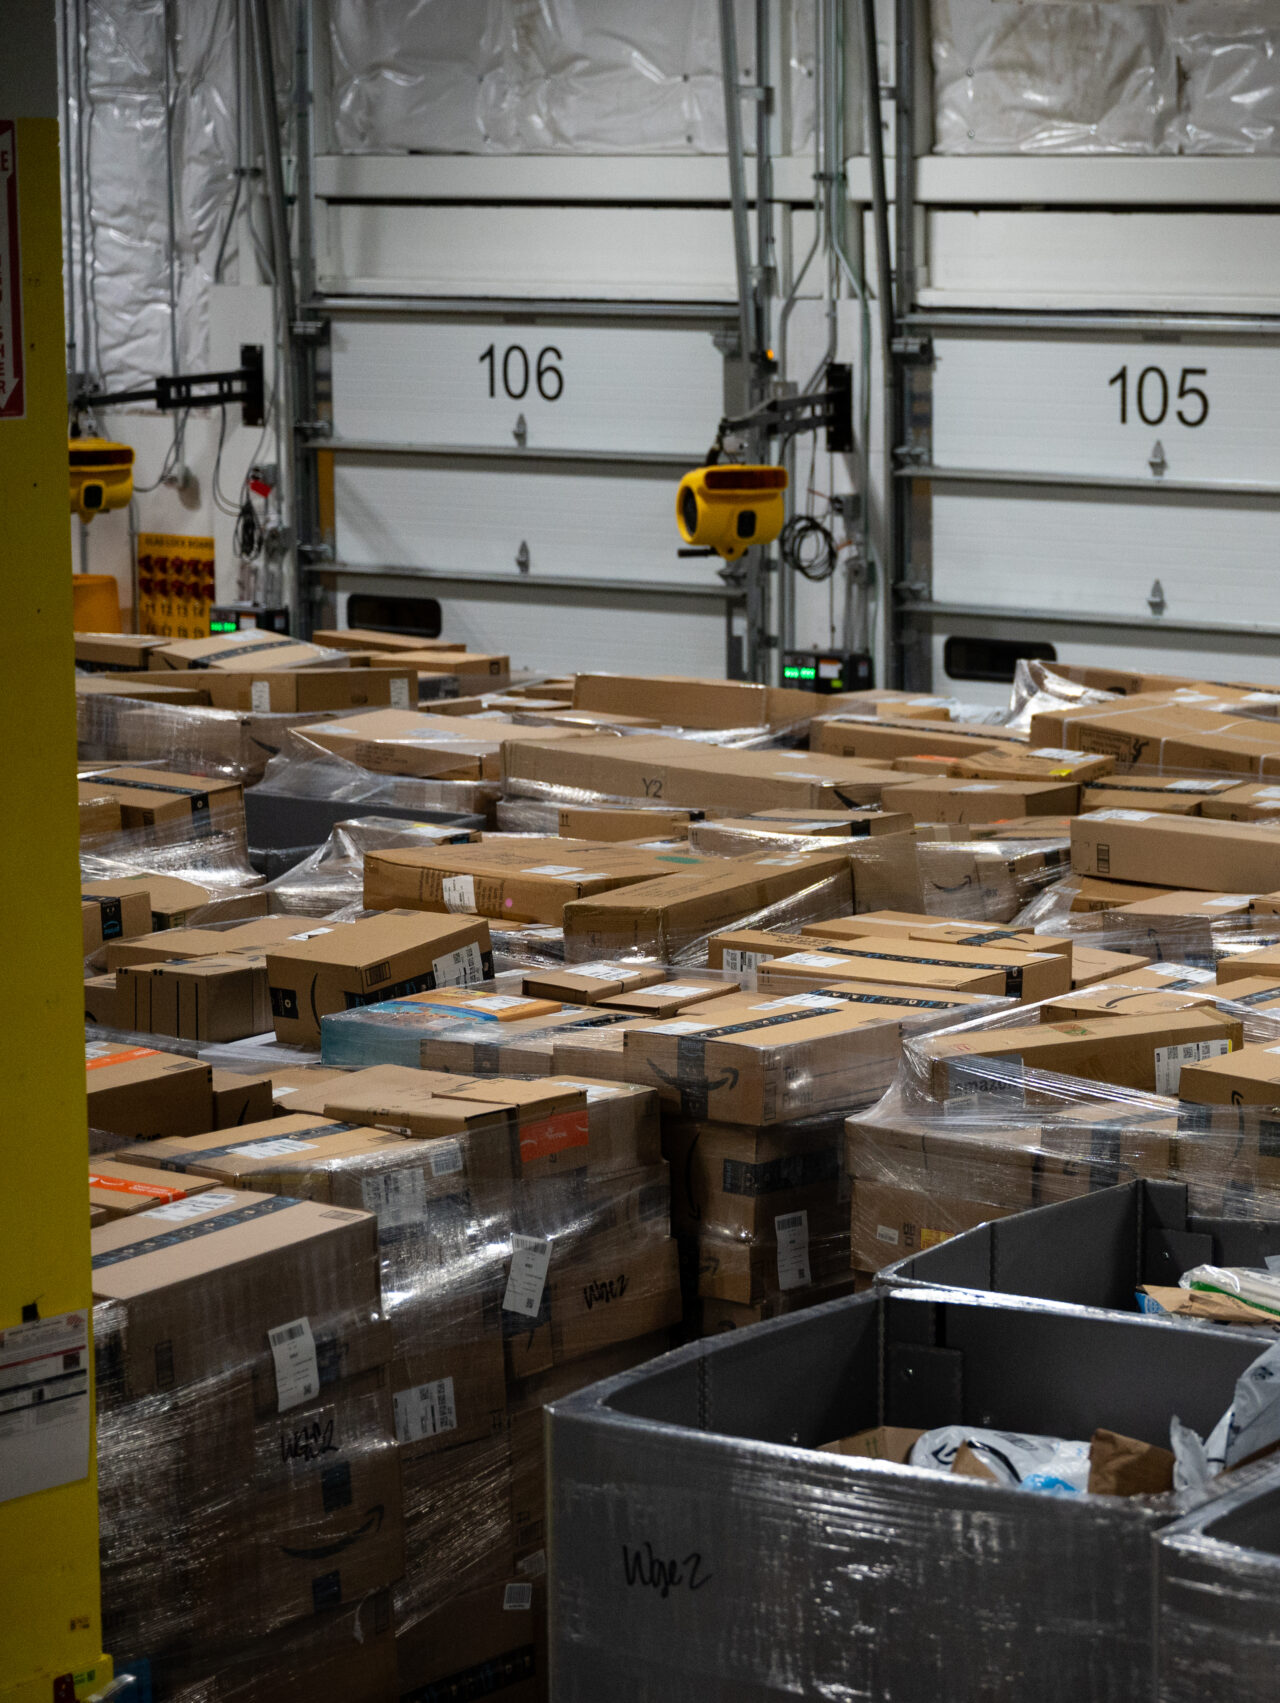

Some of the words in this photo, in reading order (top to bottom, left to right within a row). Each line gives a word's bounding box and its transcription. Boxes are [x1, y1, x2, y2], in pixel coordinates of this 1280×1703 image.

[479, 344, 564, 400] 106
[1109, 366, 1209, 426] 105
[642, 778, 663, 798] Y2
